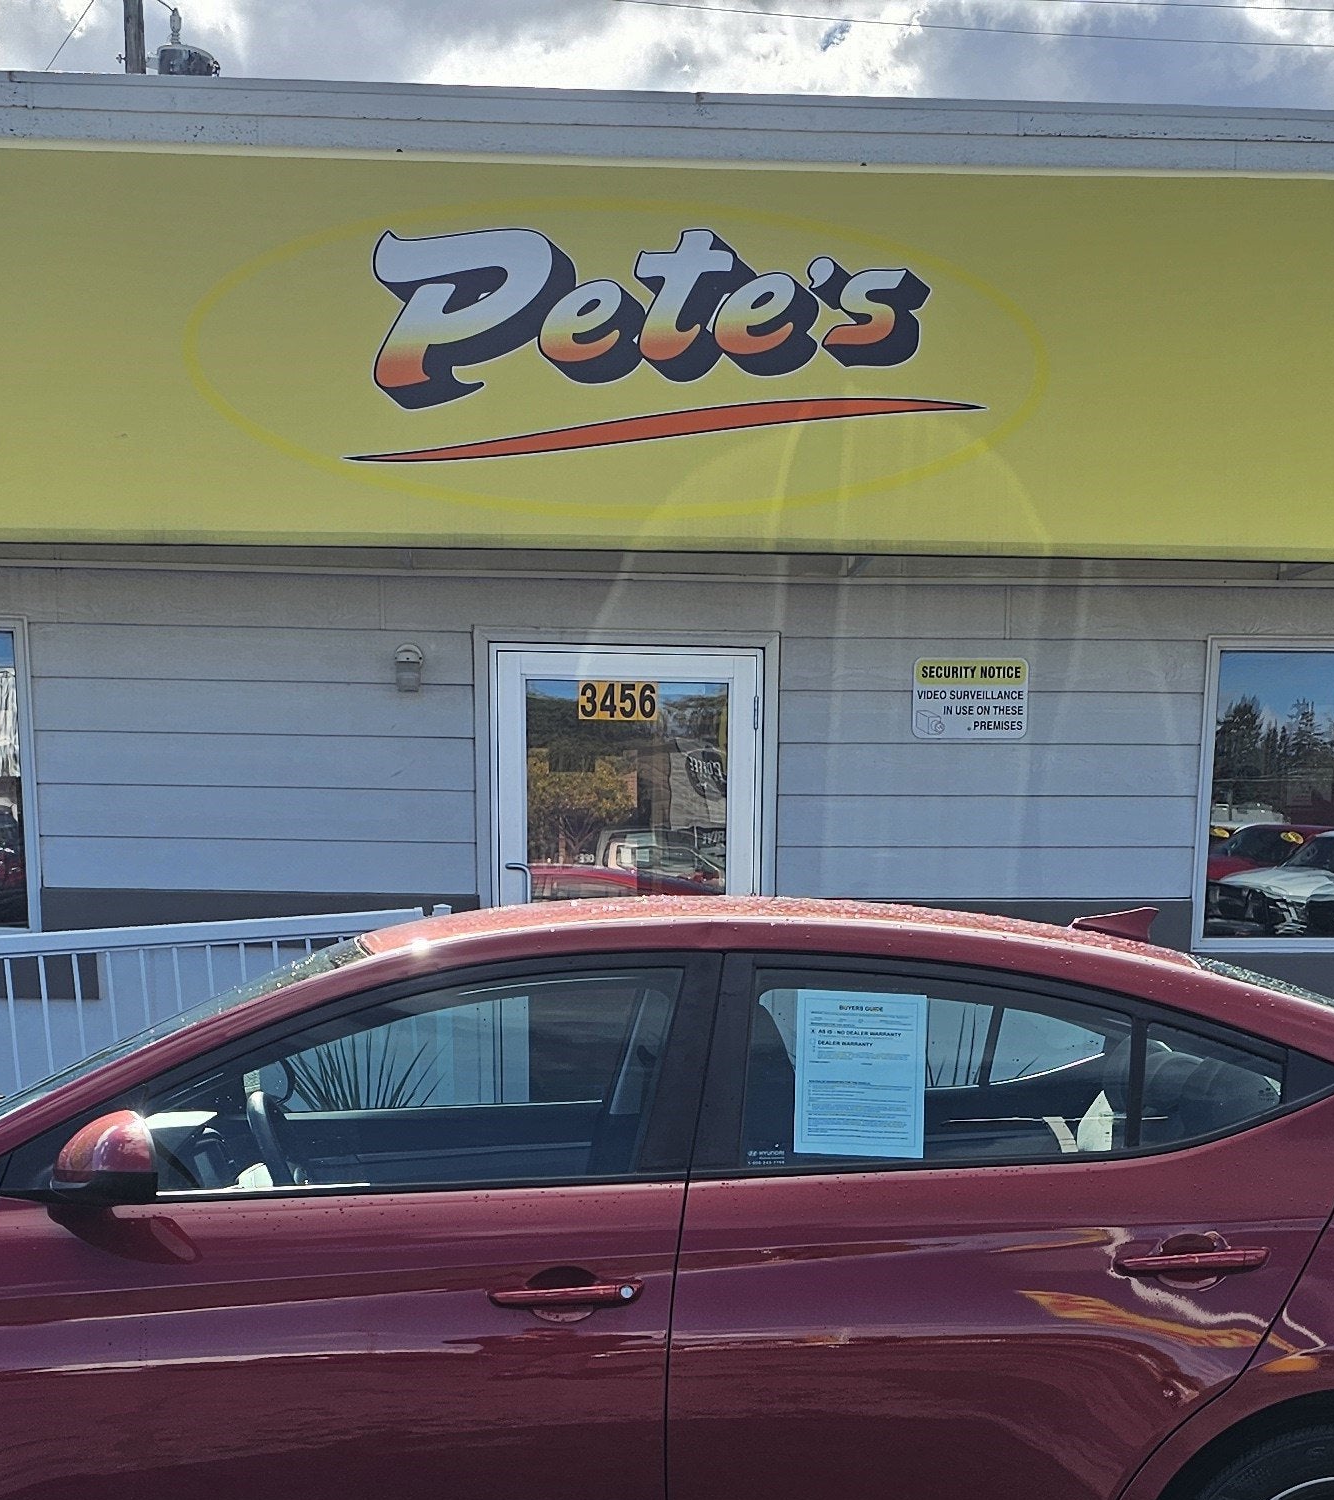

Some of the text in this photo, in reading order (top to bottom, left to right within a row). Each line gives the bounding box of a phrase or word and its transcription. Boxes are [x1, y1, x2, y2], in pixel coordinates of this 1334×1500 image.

[372, 227, 931, 410] Pete's
[921, 666, 1022, 678] SECURITY NOTICE
[579, 682, 656, 718] 3456
[917, 690, 1024, 700] VIDEO SURVEILLANCE
[943, 706, 1024, 715] IN USE ON THESE
[973, 721, 1023, 730] PREMISES
